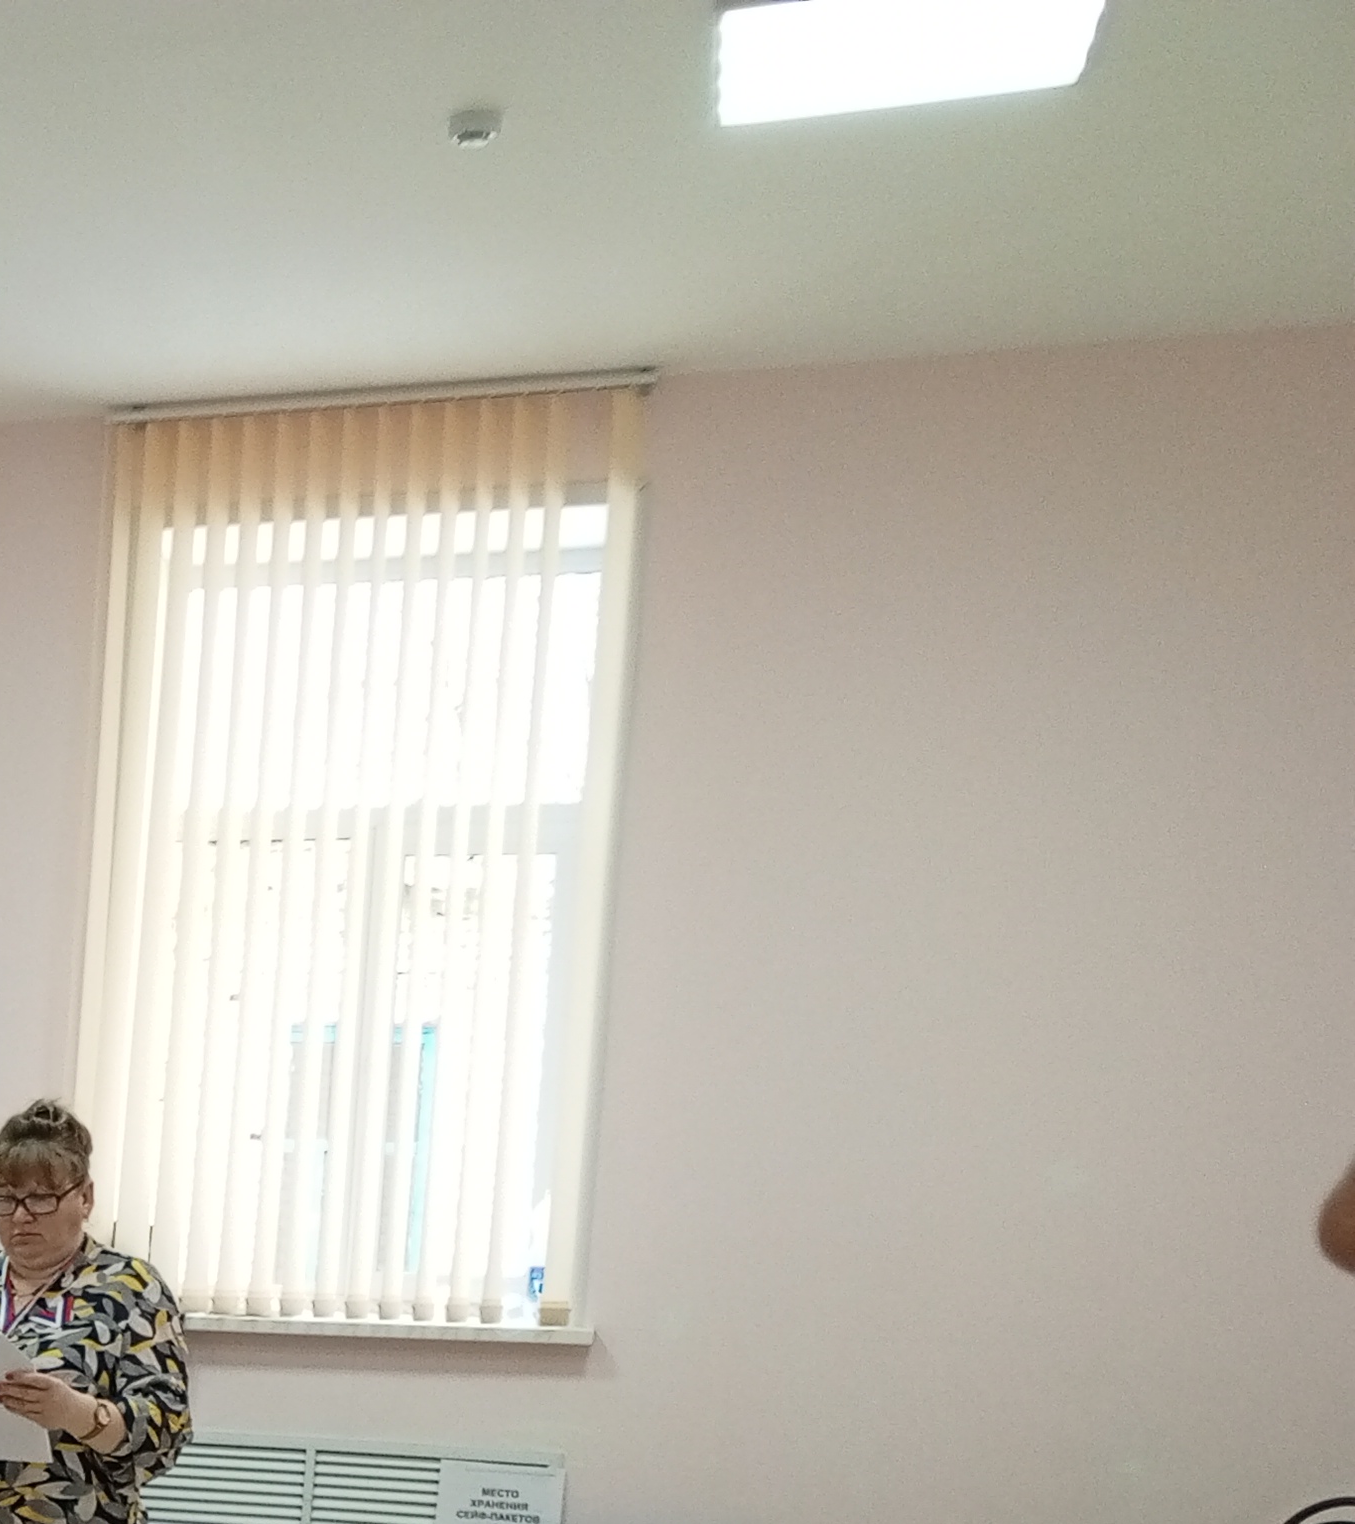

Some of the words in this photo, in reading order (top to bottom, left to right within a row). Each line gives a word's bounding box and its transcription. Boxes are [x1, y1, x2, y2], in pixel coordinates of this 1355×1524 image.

[482, 1487, 519, 1499] МЕСТО
[470, 1499, 529, 1511] ХРАНЕНИЯ
[456, 1510, 541, 1524] СЕЙФ-ПАКЕТОВ
